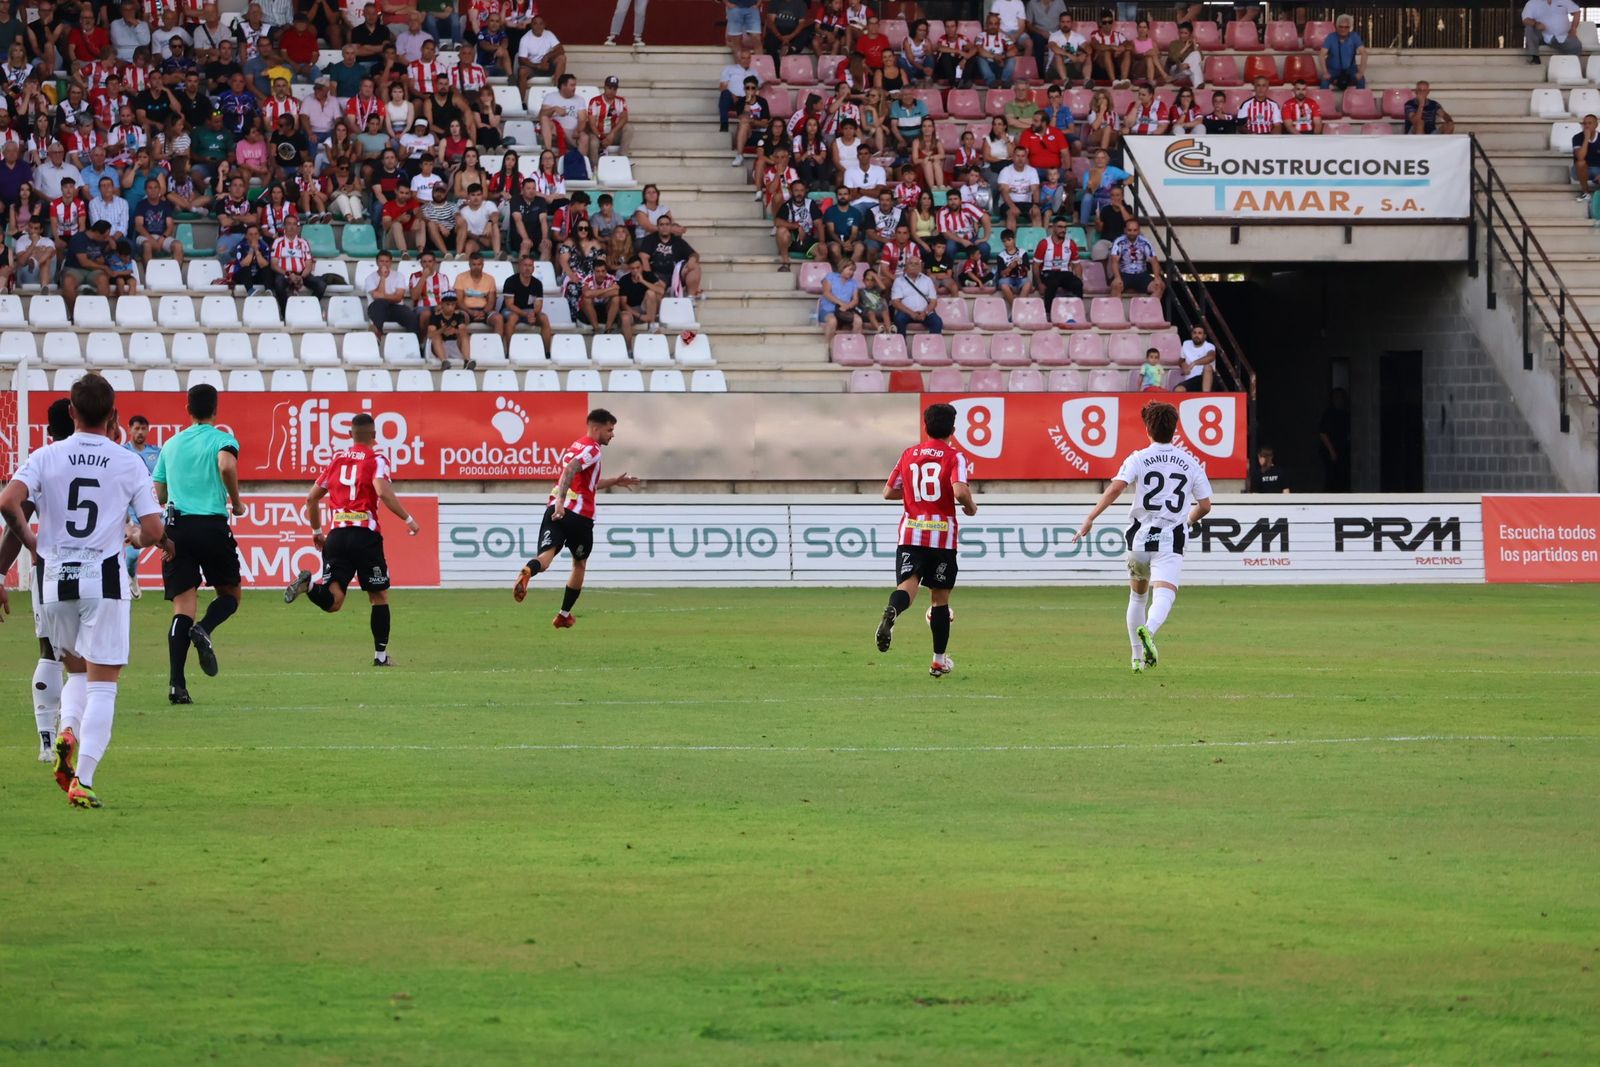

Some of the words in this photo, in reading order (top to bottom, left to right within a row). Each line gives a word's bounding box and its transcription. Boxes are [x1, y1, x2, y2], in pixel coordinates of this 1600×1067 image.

[1165, 139, 1430, 175] CONSTRUCCIONES
[1381, 198, 1425, 212] S.A.
[967, 405, 991, 447] 8
[1081, 405, 1106, 447] 8
[1198, 405, 1223, 447] 8
[68, 454, 110, 468] VADIK
[301, 435, 425, 473] reapt
[440, 441, 566, 475] podoactiv
[1047, 425, 1090, 475] ZAMORA
[1143, 454, 1168, 468] MANU
[1170, 455, 1189, 472] RICO
[339, 465, 357, 500] 4
[459, 465, 509, 475] PODOLOGÍA
[511, 466, 516, 475] Y
[909, 462, 941, 502] 18
[66, 477, 100, 538] 5
[1143, 471, 1188, 513] 23
[450, 527, 572, 558] SOL
[606, 527, 778, 558] STUDIO
[803, 527, 897, 558] SOL
[958, 527, 1127, 558] STUDIO
[1334, 517, 1461, 552] PRM
[1499, 524, 1555, 539] Escucha
[1557, 524, 1597, 539] todos
[1243, 558, 1290, 566] RACING
[1415, 557, 1462, 565] RACING
[1500, 546, 1520, 562] los
[1523, 546, 1578, 565] partidos
[1581, 550, 1598, 562] en
